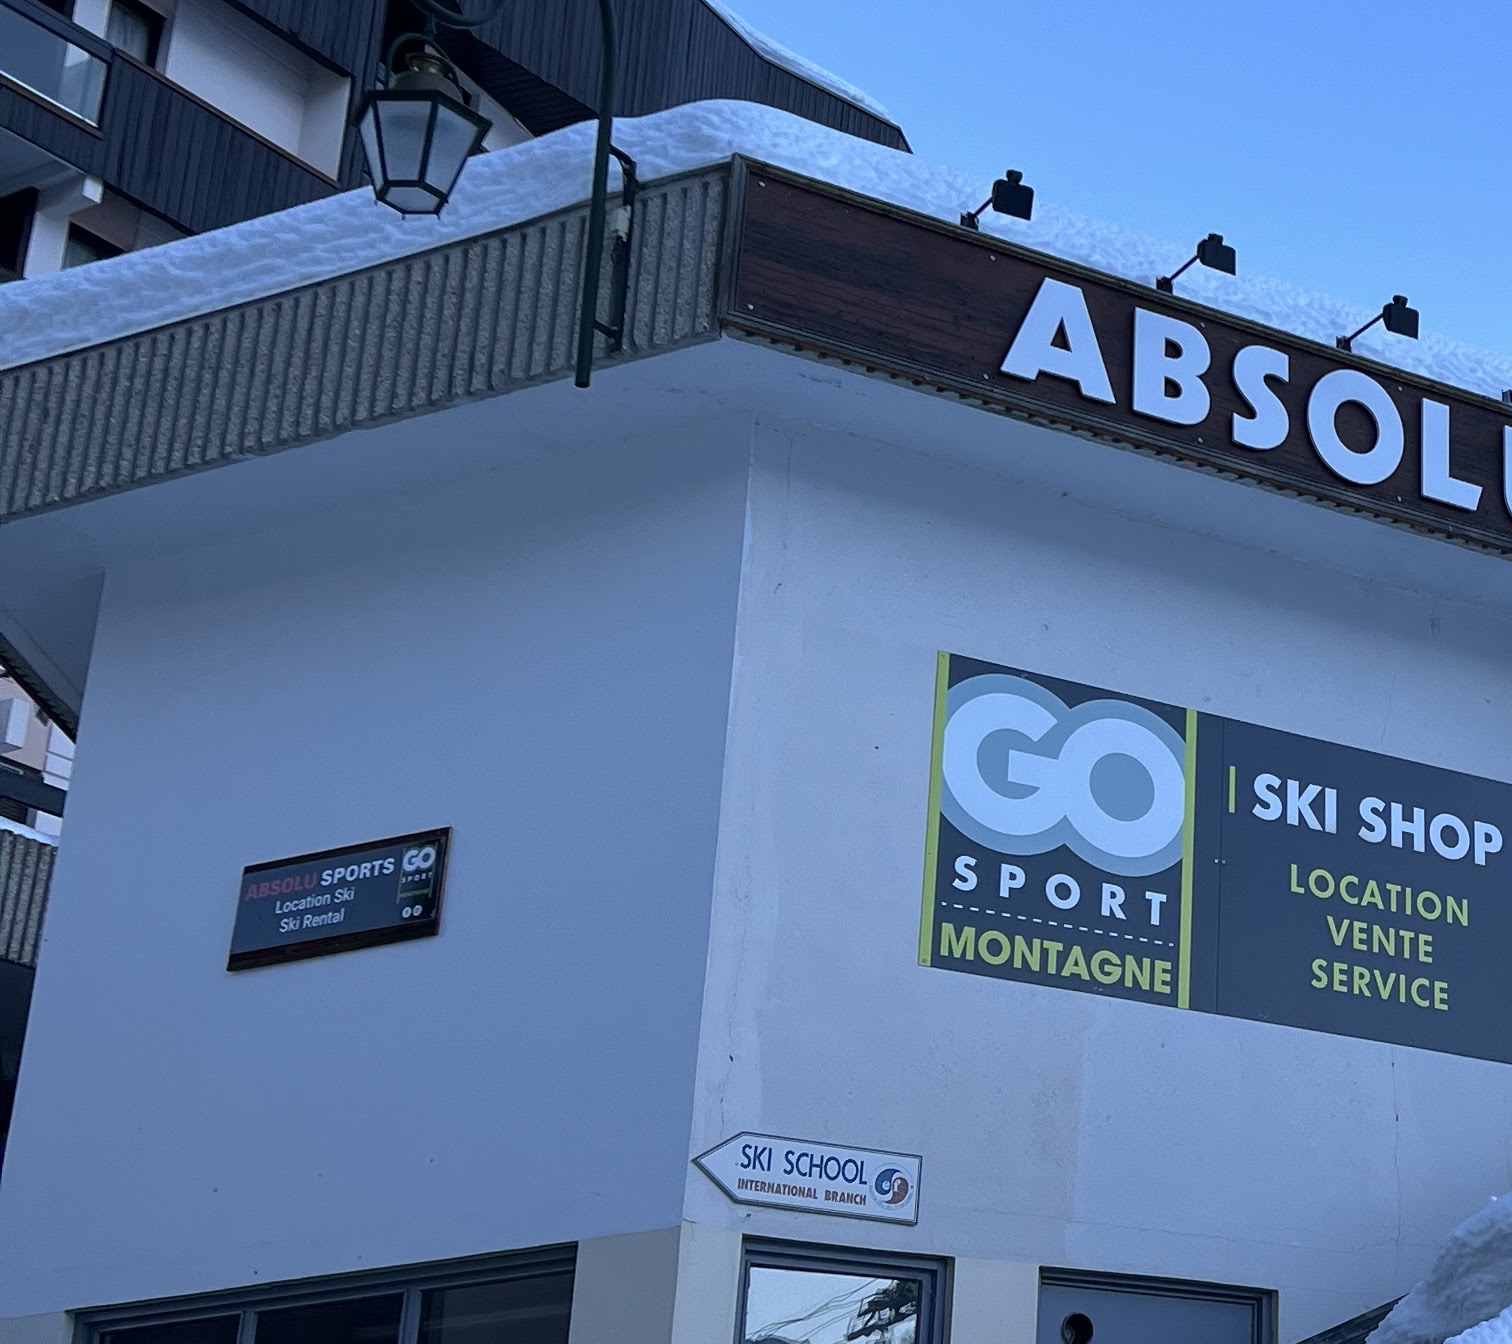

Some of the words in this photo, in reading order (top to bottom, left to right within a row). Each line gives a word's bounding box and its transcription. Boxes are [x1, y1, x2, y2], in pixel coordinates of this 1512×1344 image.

[942, 692, 1186, 858] GO
[1251, 772, 1338, 835] SKI
[1357, 796, 1504, 867] SHOP
[245, 872, 318, 901] ABSOLU
[320, 857, 396, 887] SPORTS
[400, 871, 433, 884] SPORT
[402, 846, 436, 872] GO
[274, 893, 331, 915] Location
[333, 886, 356, 905] Ski
[951, 855, 1168, 927] SPORT
[1289, 863, 1470, 927] LOCATION
[279, 915, 301, 933] Ski
[302, 908, 345, 929] Rental
[1326, 915, 1433, 964] VENTE
[940, 922, 1173, 996] MONTAGNE
[1310, 958, 1449, 1012] SERVICE
[739, 1143, 773, 1172] SKI
[783, 1149, 868, 1186] SCHOOL
[737, 1177, 818, 1200] INTERNATIONAL
[824, 1189, 867, 1206] BRANCH
